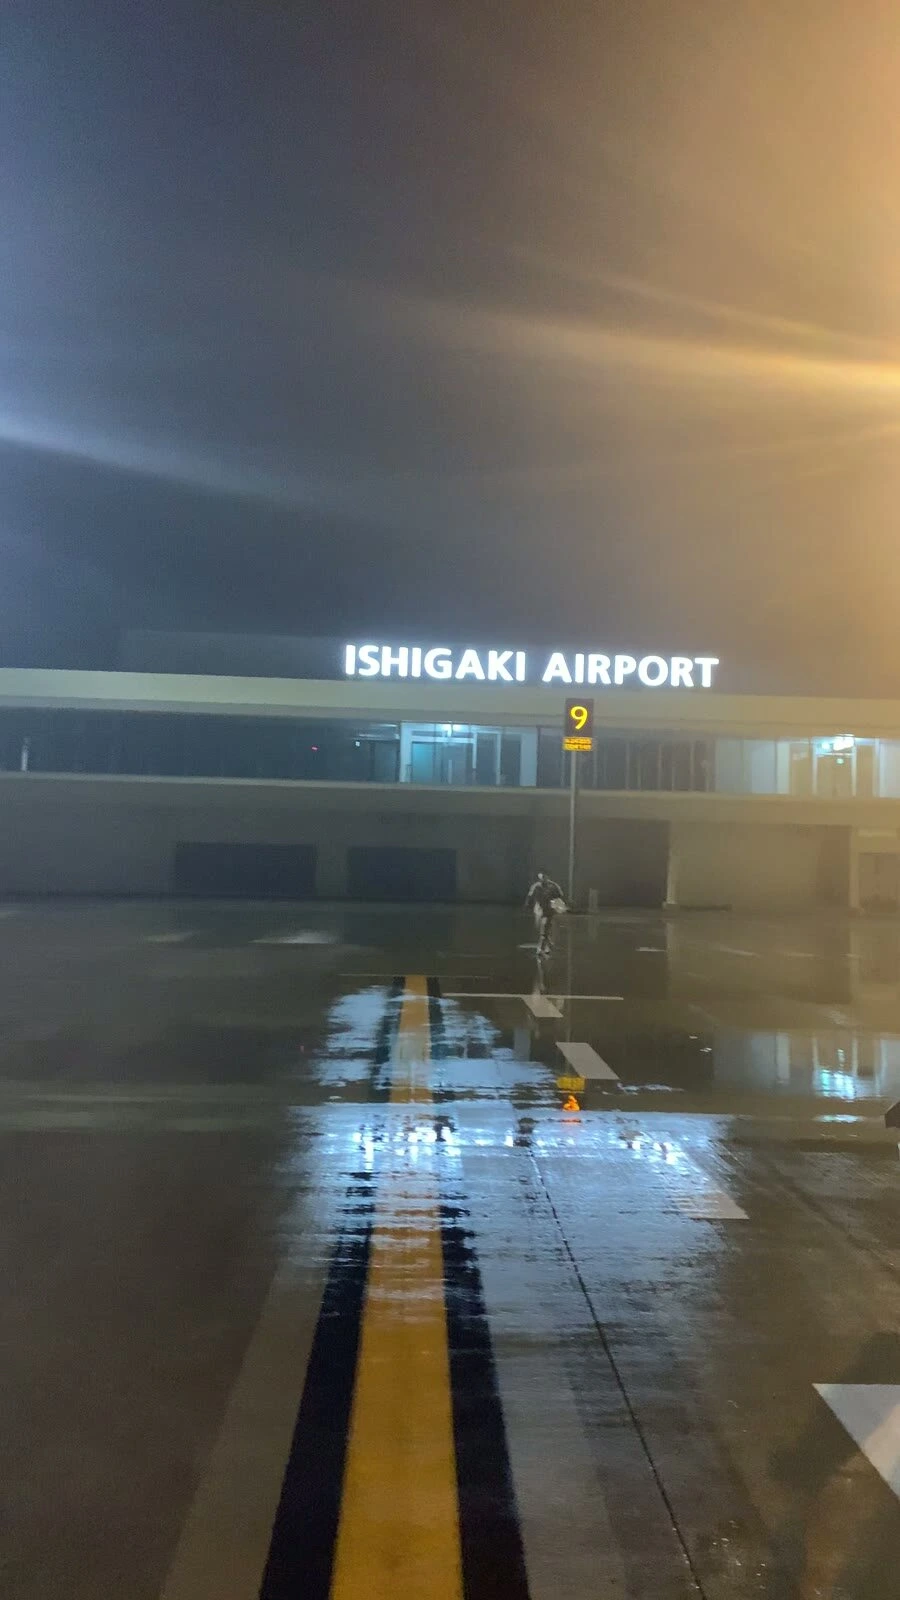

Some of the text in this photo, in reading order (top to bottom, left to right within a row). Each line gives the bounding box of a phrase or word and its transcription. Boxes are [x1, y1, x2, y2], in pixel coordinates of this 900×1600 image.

[345, 644, 720, 688] ISHIGAKI AIRPORT
[570, 705, 588, 730] 9
